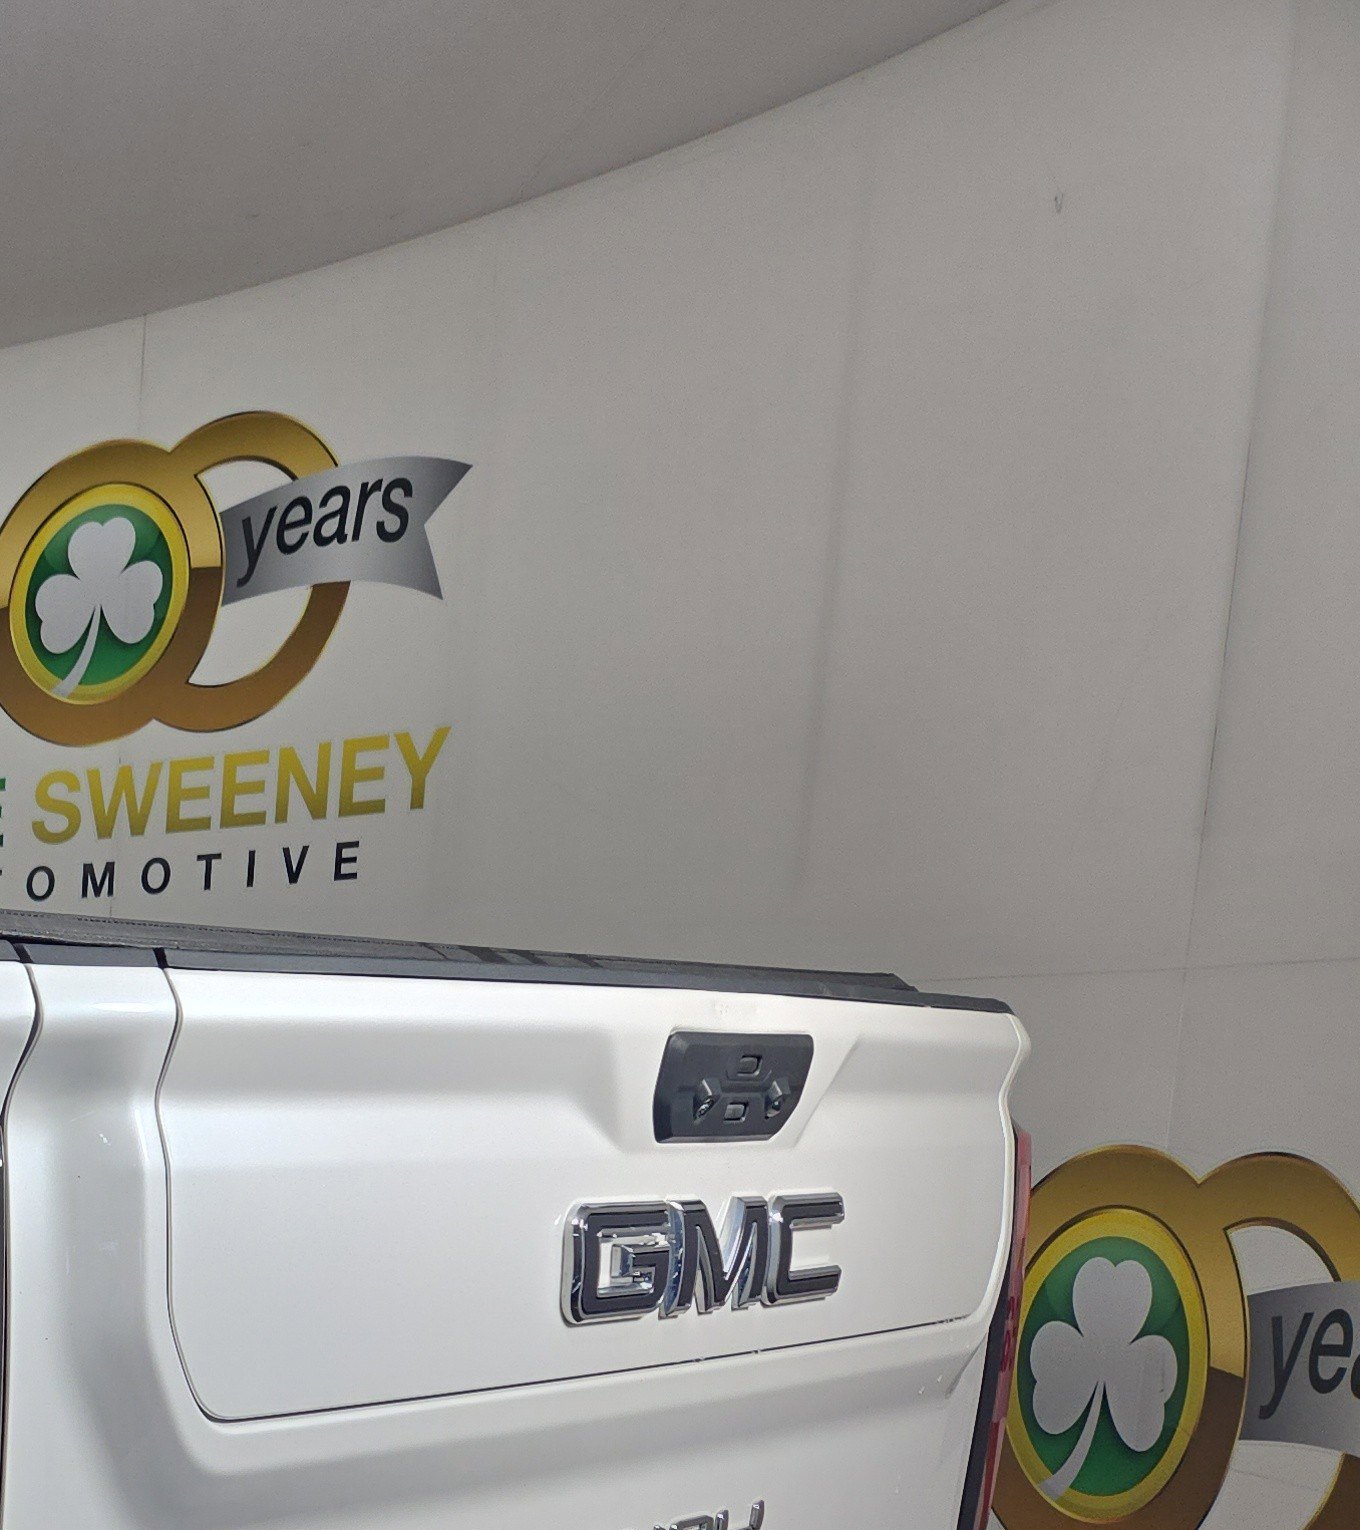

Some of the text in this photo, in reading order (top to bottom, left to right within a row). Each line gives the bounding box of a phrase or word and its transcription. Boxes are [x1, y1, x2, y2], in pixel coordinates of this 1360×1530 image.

[236, 477, 413, 588] years
[31, 726, 452, 846] SWEENEY
[560, 1191, 845, 1327] GMC
